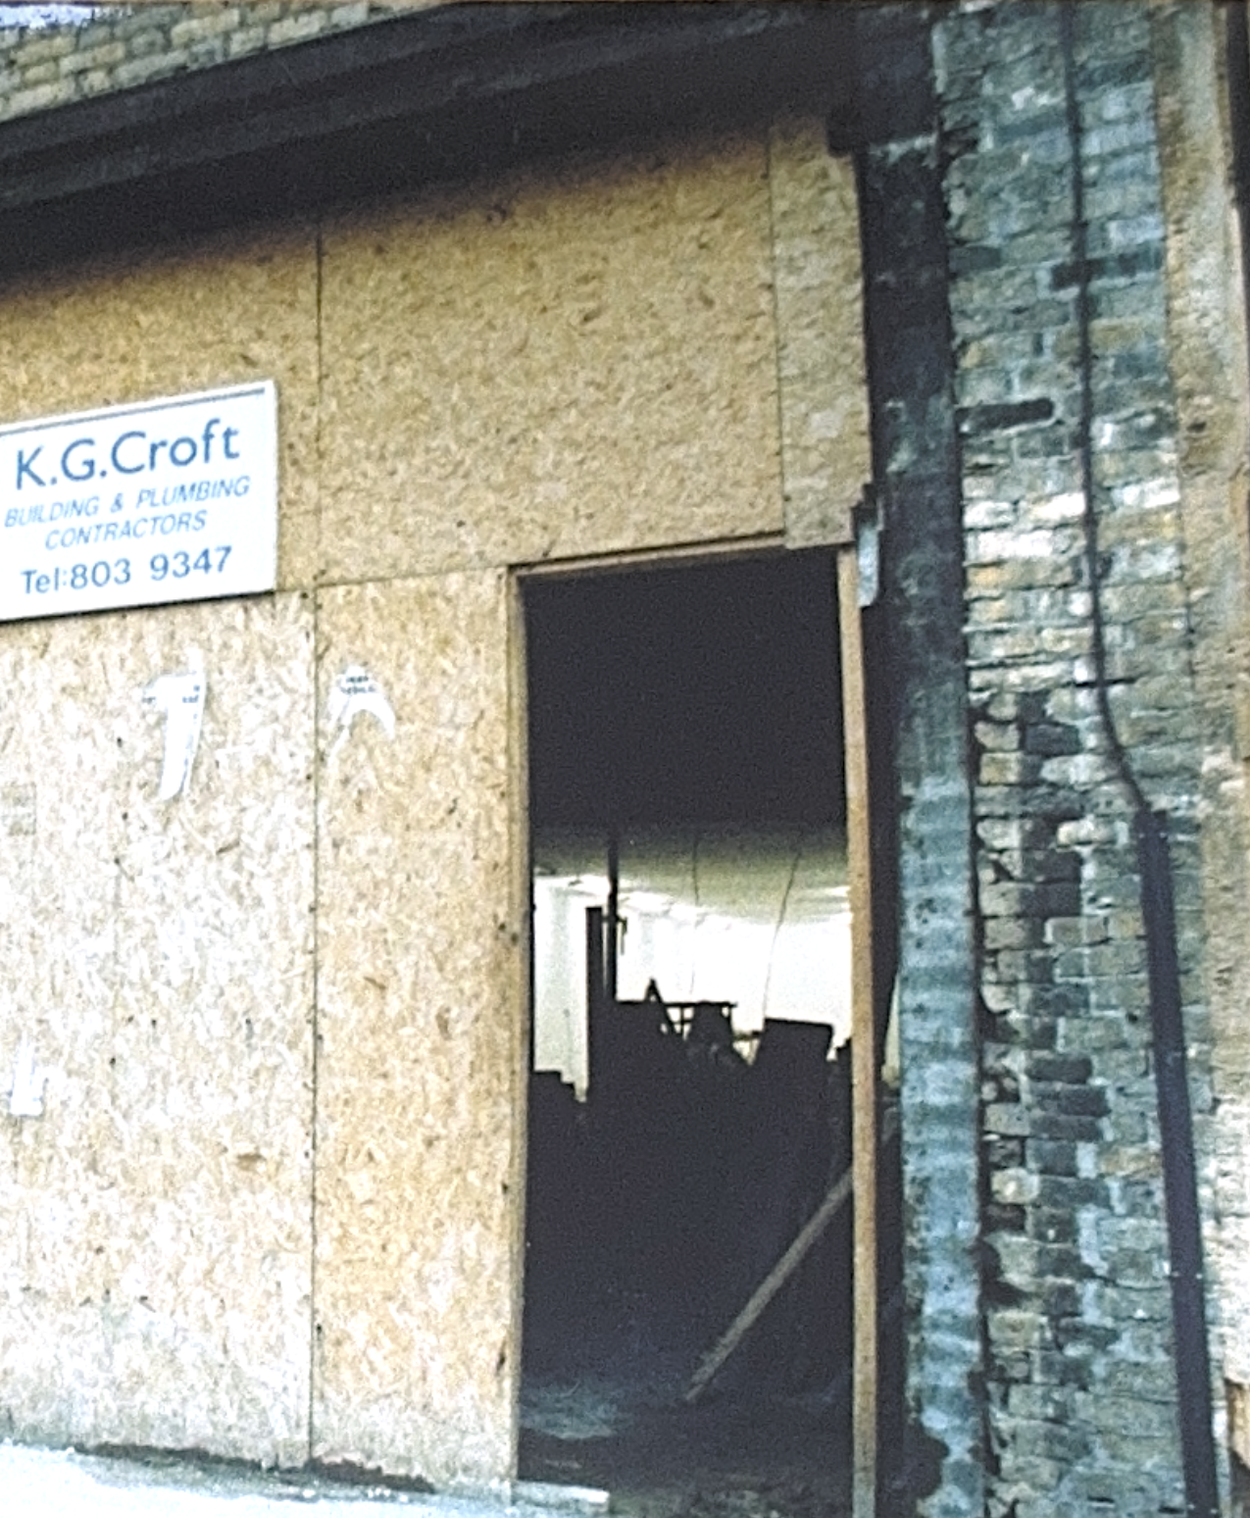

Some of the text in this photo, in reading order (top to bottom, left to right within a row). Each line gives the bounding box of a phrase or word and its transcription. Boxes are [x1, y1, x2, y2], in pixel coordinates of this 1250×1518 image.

[4, 475, 250, 528] BUILDING & PLUMBING
[44, 509, 208, 551] CONTRACTORS
[150, 545, 233, 581] 9347
